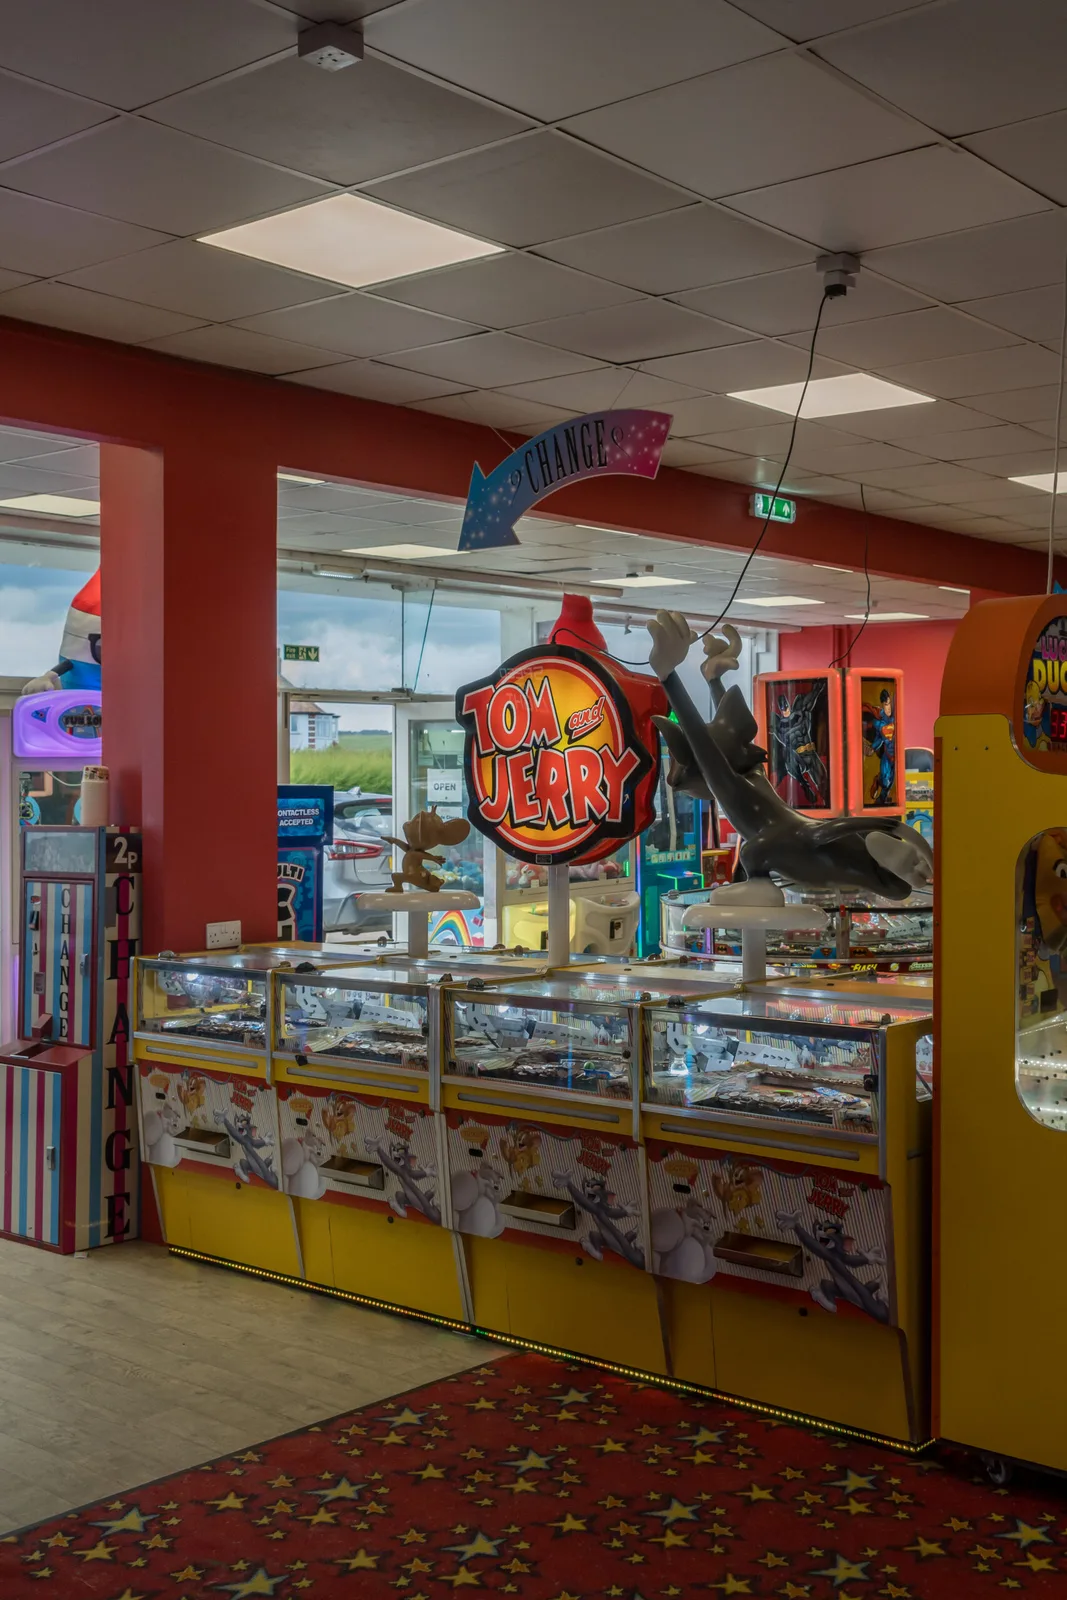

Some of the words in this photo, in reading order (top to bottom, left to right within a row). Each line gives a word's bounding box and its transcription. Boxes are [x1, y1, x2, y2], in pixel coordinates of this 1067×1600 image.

[524, 419, 608, 494] CHANGE
[86, 715, 102, 726] ZO
[462, 676, 562, 755] TOM
[568, 696, 606, 731] and
[433, 782, 456, 791] OPEN
[479, 745, 641, 825] JERRY
[277, 809, 319, 817] ONTACTLESS
[279, 818, 314, 826] ACCEPTED
[277, 863, 305, 883] ULTI
[59, 888, 71, 1038] CHANGE
[104, 876, 139, 1239] CHANGE
